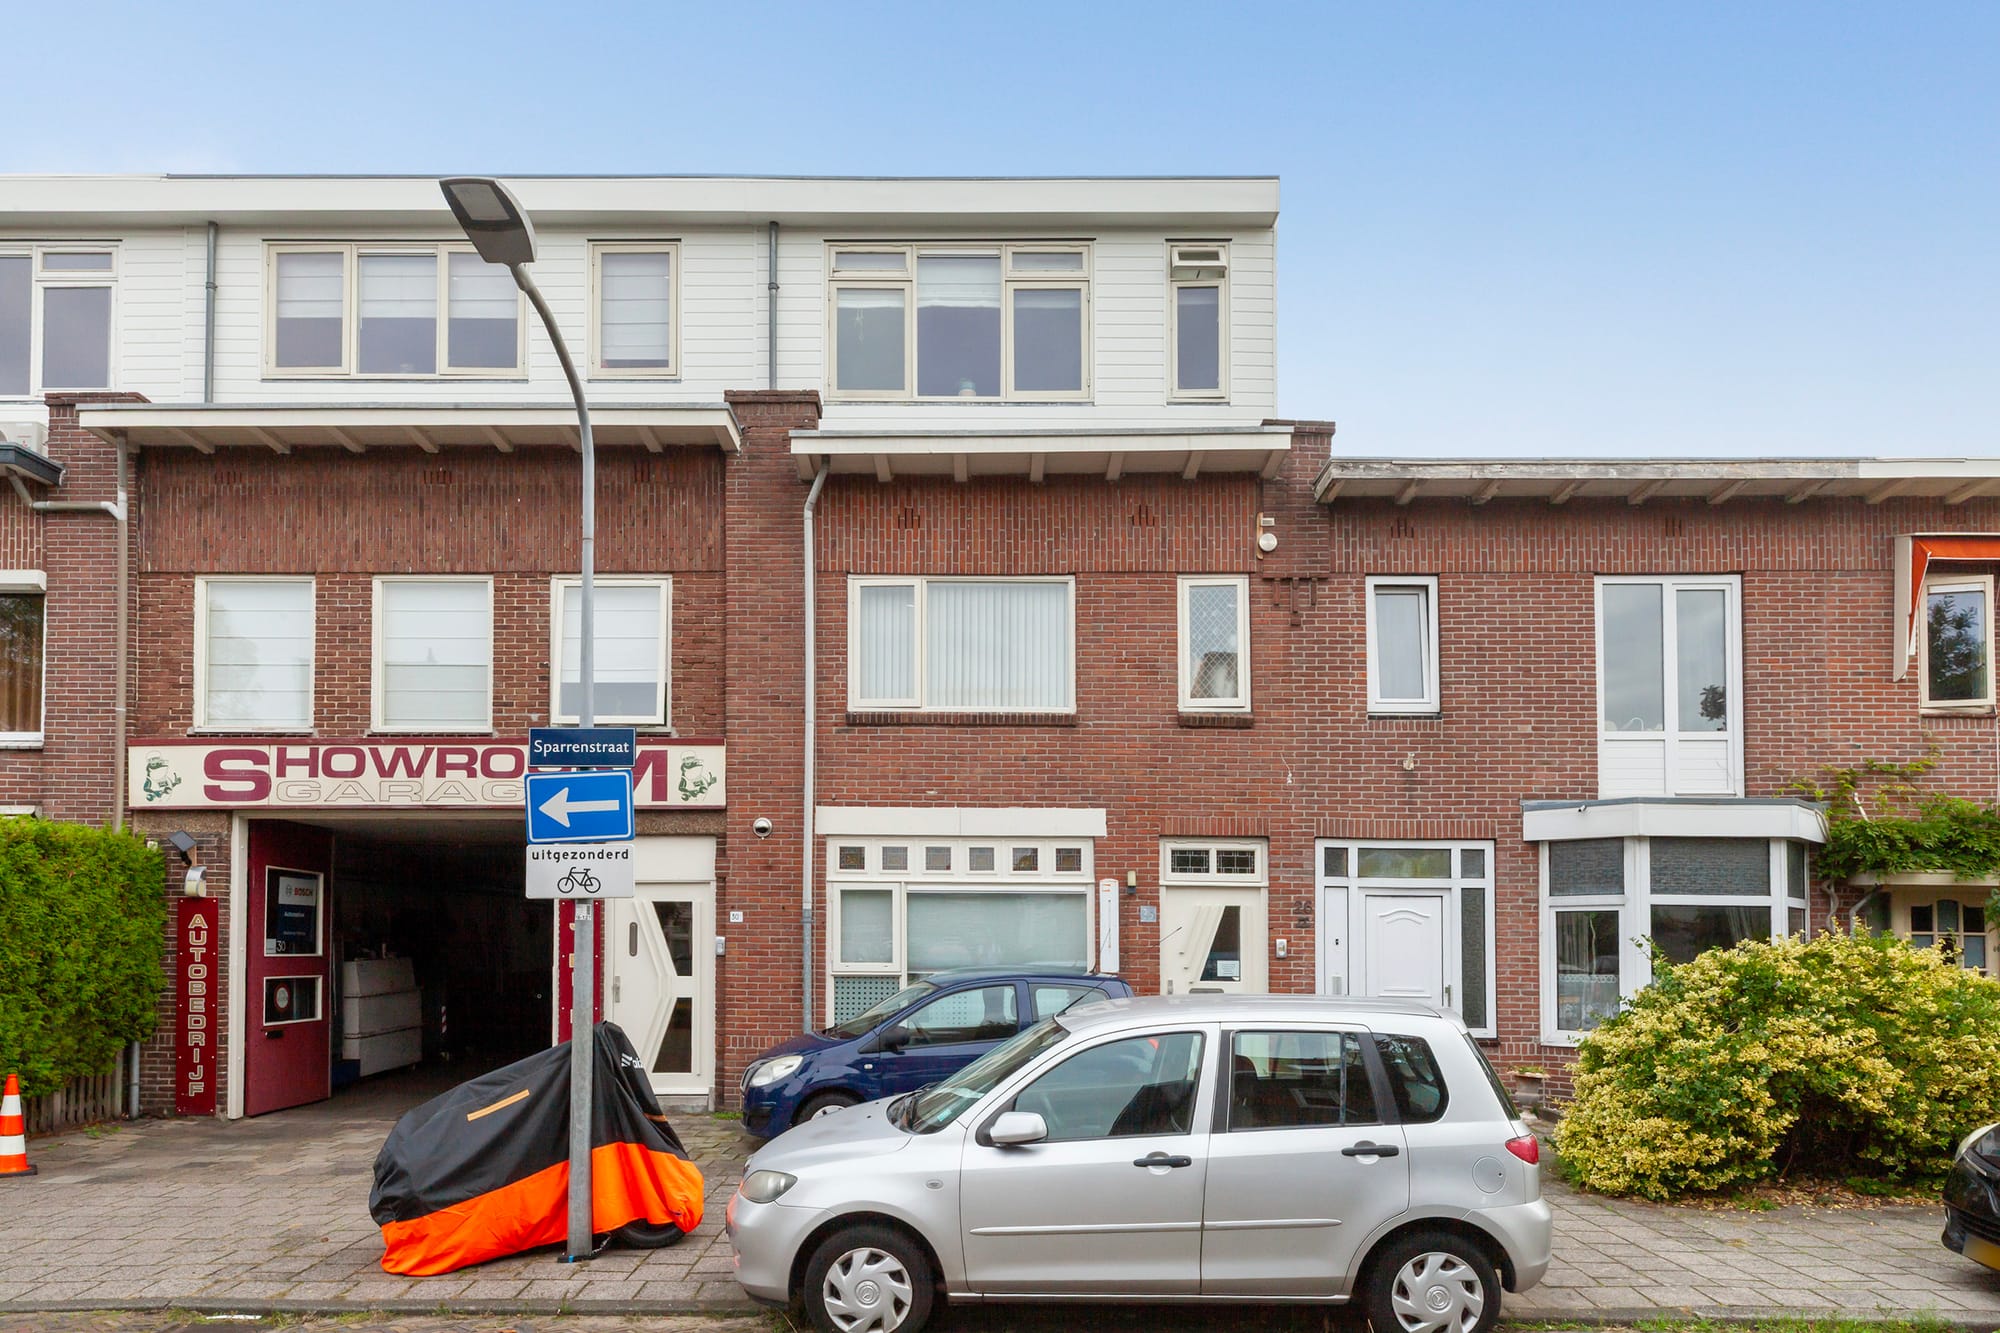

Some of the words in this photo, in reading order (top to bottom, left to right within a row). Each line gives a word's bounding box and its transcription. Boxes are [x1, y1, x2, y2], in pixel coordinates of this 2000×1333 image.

[533, 740, 630, 757] Sparrenstraat
[203, 746, 668, 802] SHOWROM
[276, 780, 526, 802] GARAG
[531, 848, 629, 863] uitgezonderd
[294, 887, 313, 897] BOSCH
[1293, 900, 1312, 915] 26
[276, 940, 286, 952] 30
[188, 913, 208, 1097] AUTOBEDRIJF
